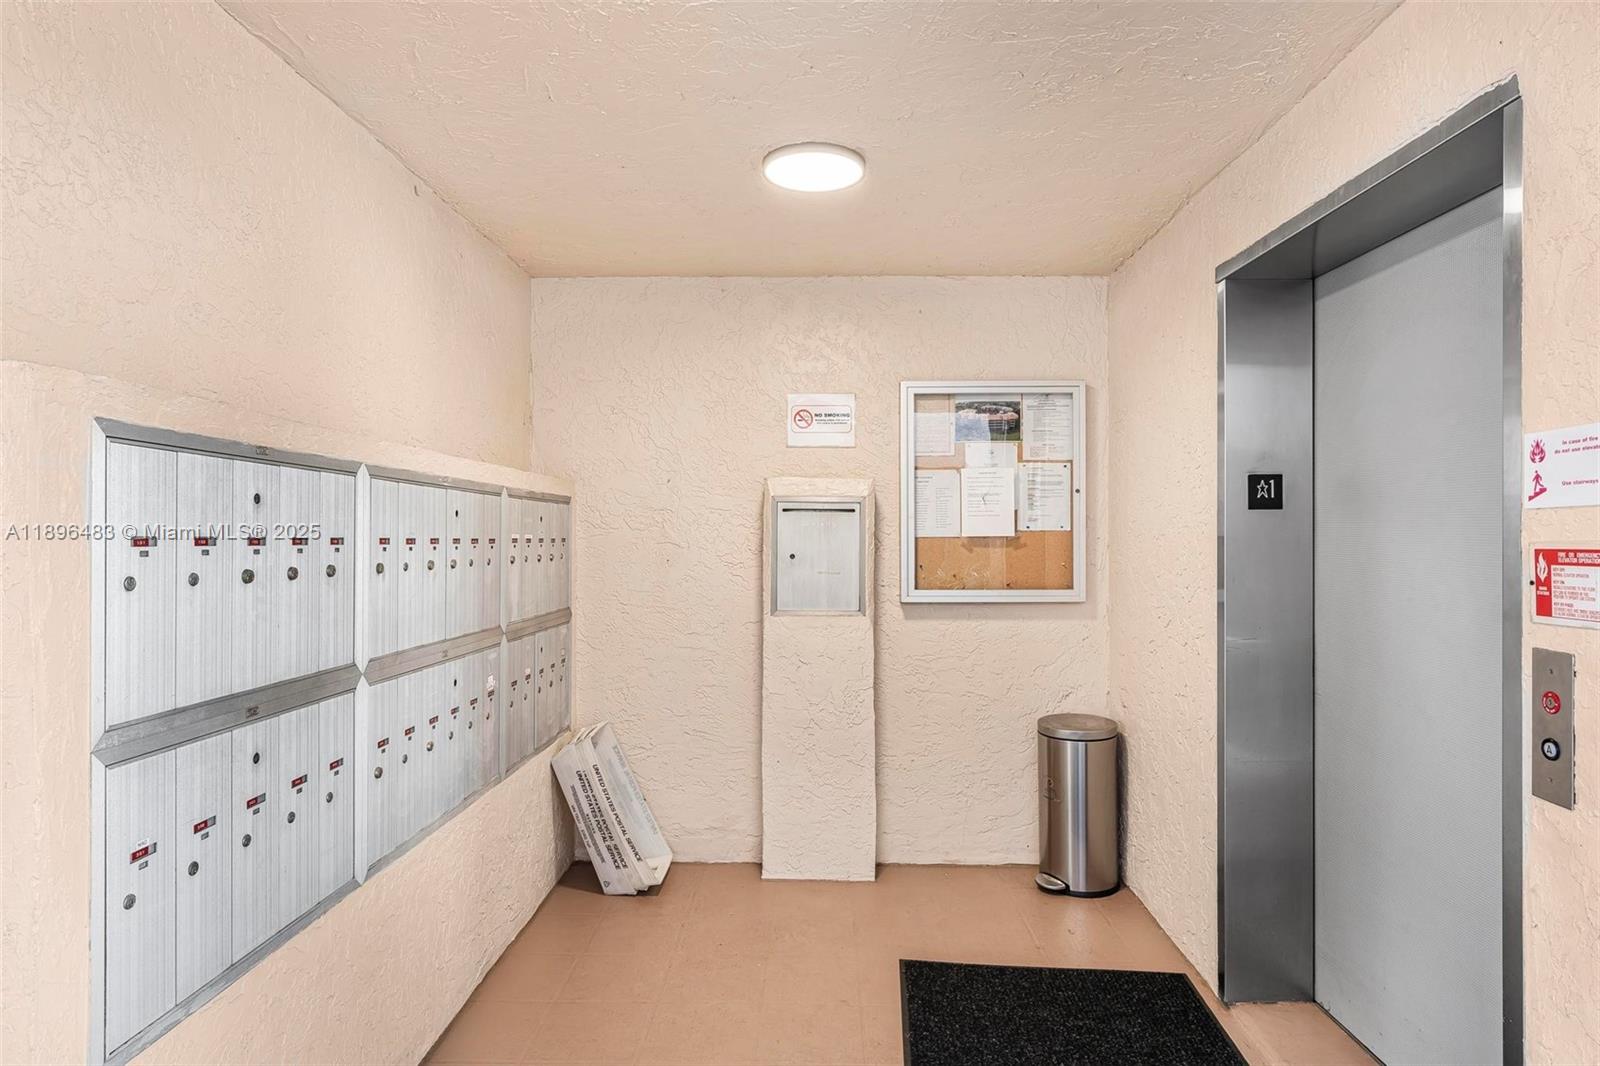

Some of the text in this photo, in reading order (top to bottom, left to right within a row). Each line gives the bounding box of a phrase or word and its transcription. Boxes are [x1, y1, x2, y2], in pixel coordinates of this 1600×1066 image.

[575, 770, 588, 793] UNITED
[584, 794, 598, 818] STATES
[594, 819, 607, 843] POSTAL
[604, 844, 621, 869] SERVICE
[591, 763, 642, 861] UNITED STATES POSTAL SERVICE
[612, 843, 628, 868] SERVICE
